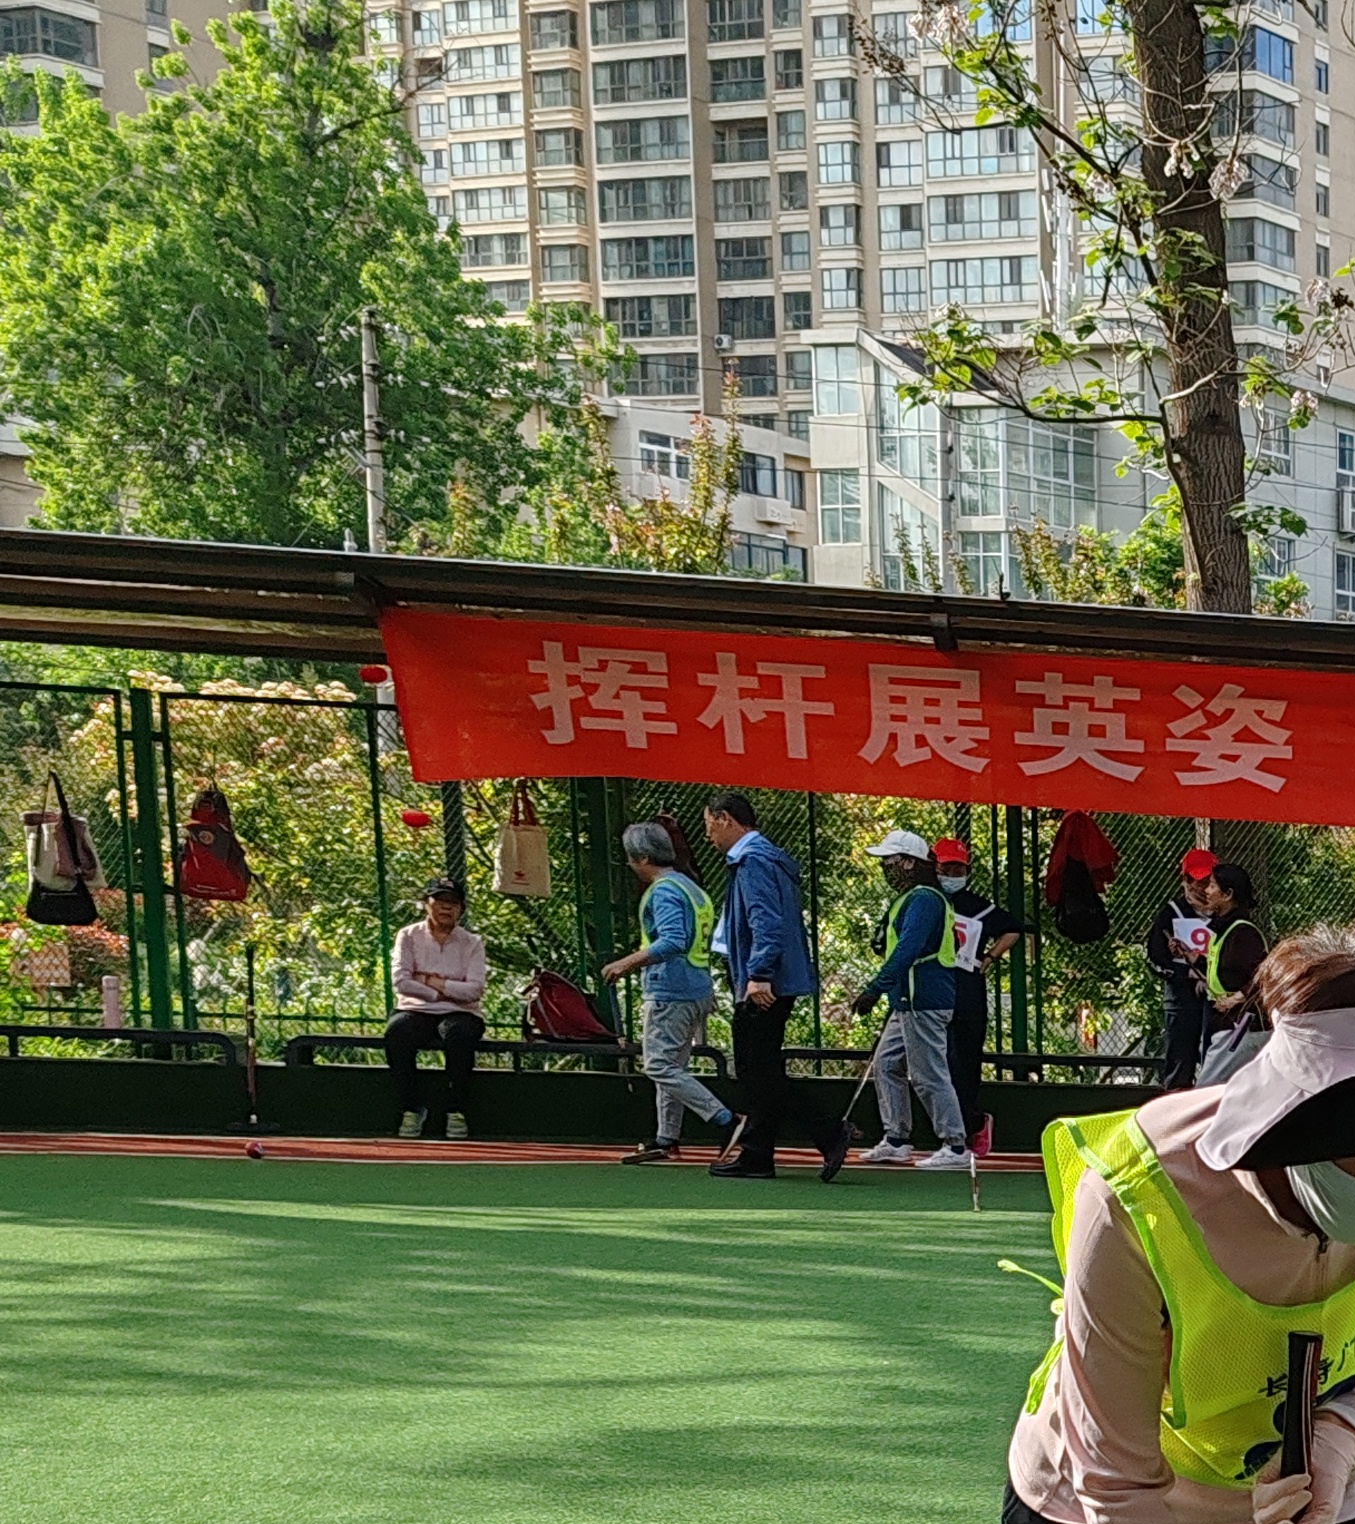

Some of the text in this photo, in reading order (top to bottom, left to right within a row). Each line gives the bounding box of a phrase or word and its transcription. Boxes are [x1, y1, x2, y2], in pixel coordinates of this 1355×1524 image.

[527, 640, 1294, 793] 挥杆展英姿
